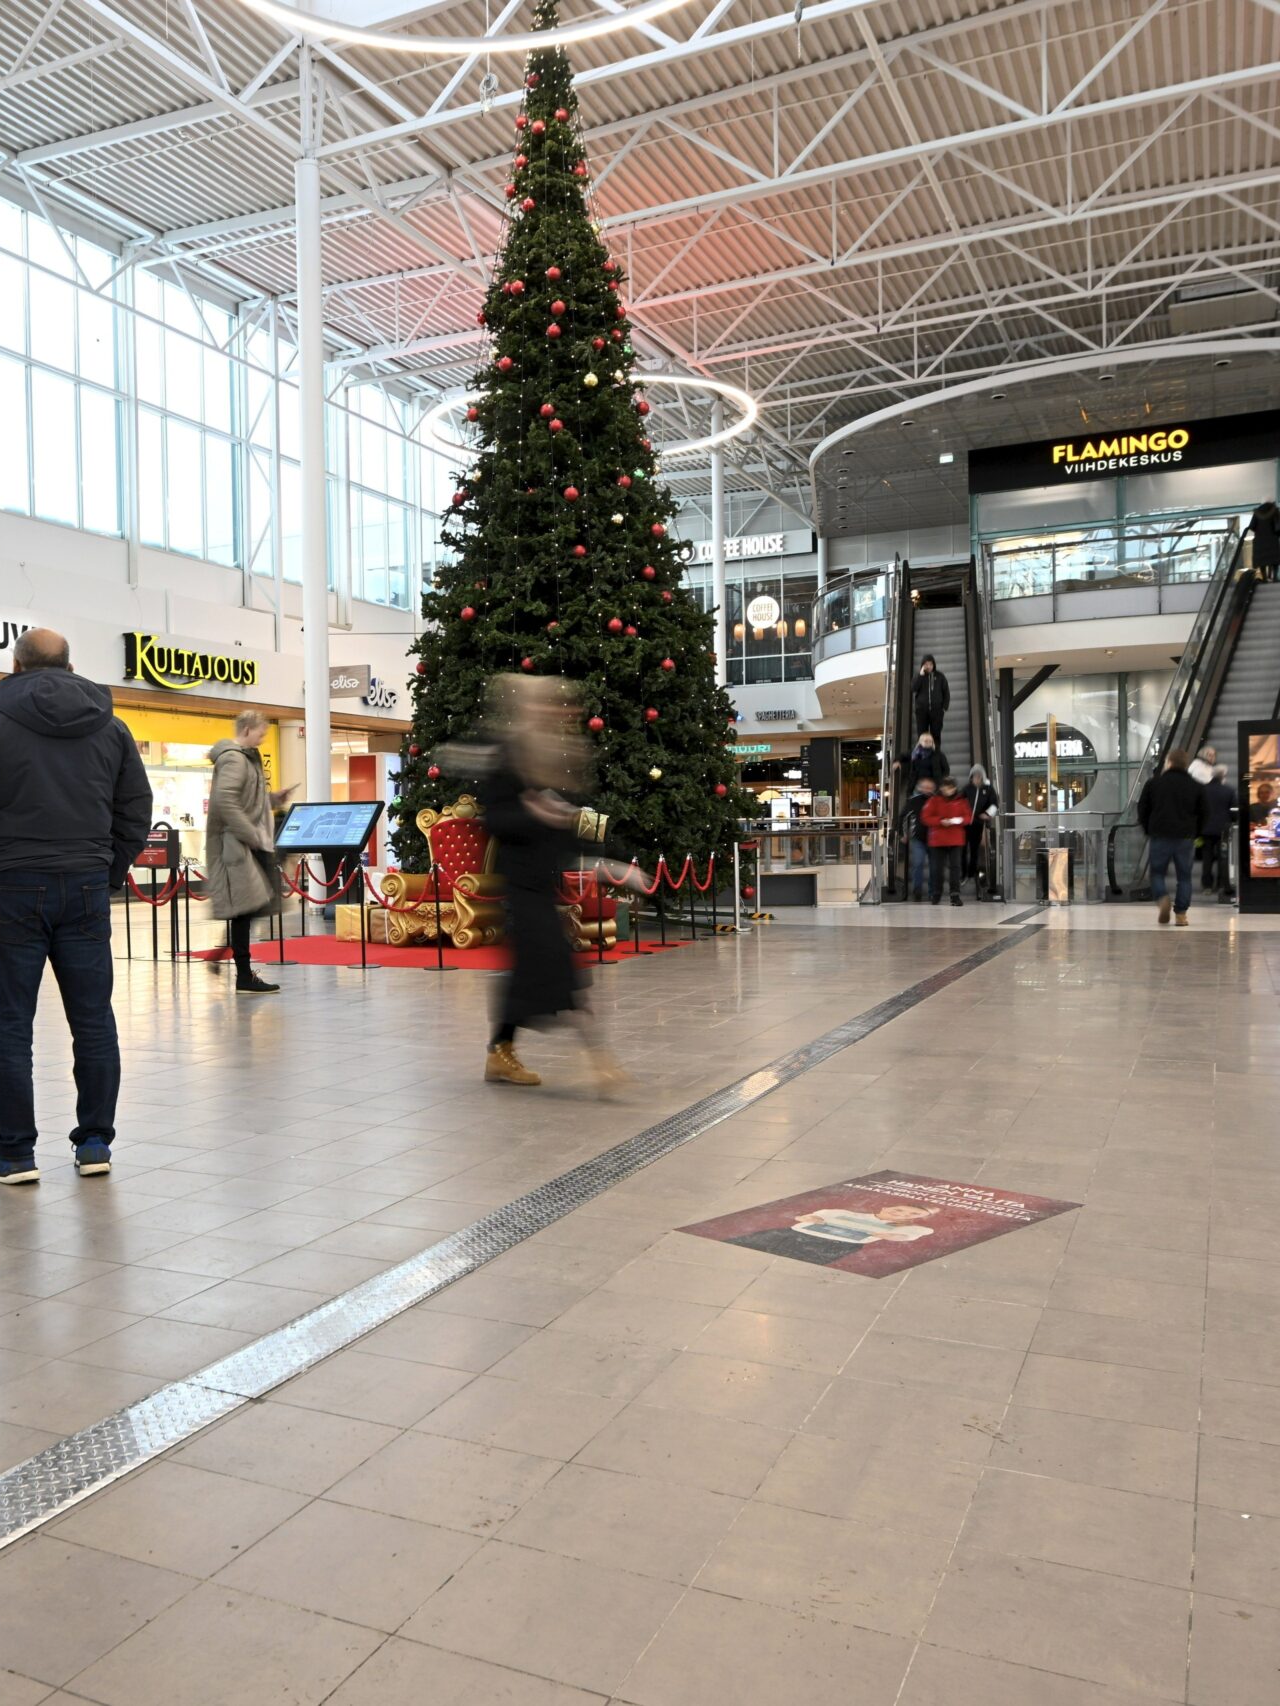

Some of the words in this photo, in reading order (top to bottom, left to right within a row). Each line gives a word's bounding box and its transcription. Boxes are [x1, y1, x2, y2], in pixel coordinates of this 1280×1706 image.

[1053, 429, 1189, 464] FLAMINGO
[1064, 451, 1183, 475] VIIHDEKESKUS
[700, 540, 740, 559] COFEE
[741, 533, 784, 556] HOUSE
[752, 603, 773, 612] COFFEE
[752, 613, 773, 621] HOUSE
[133, 632, 260, 689] KULTAJOUSI
[331, 674, 360, 689] elisa
[367, 677, 399, 708] elisa
[1014, 740, 1083, 758] SPAGHTERIA
[934, 1184, 995, 1197] ANNA
[963, 1192, 1025, 1208] VALITA
